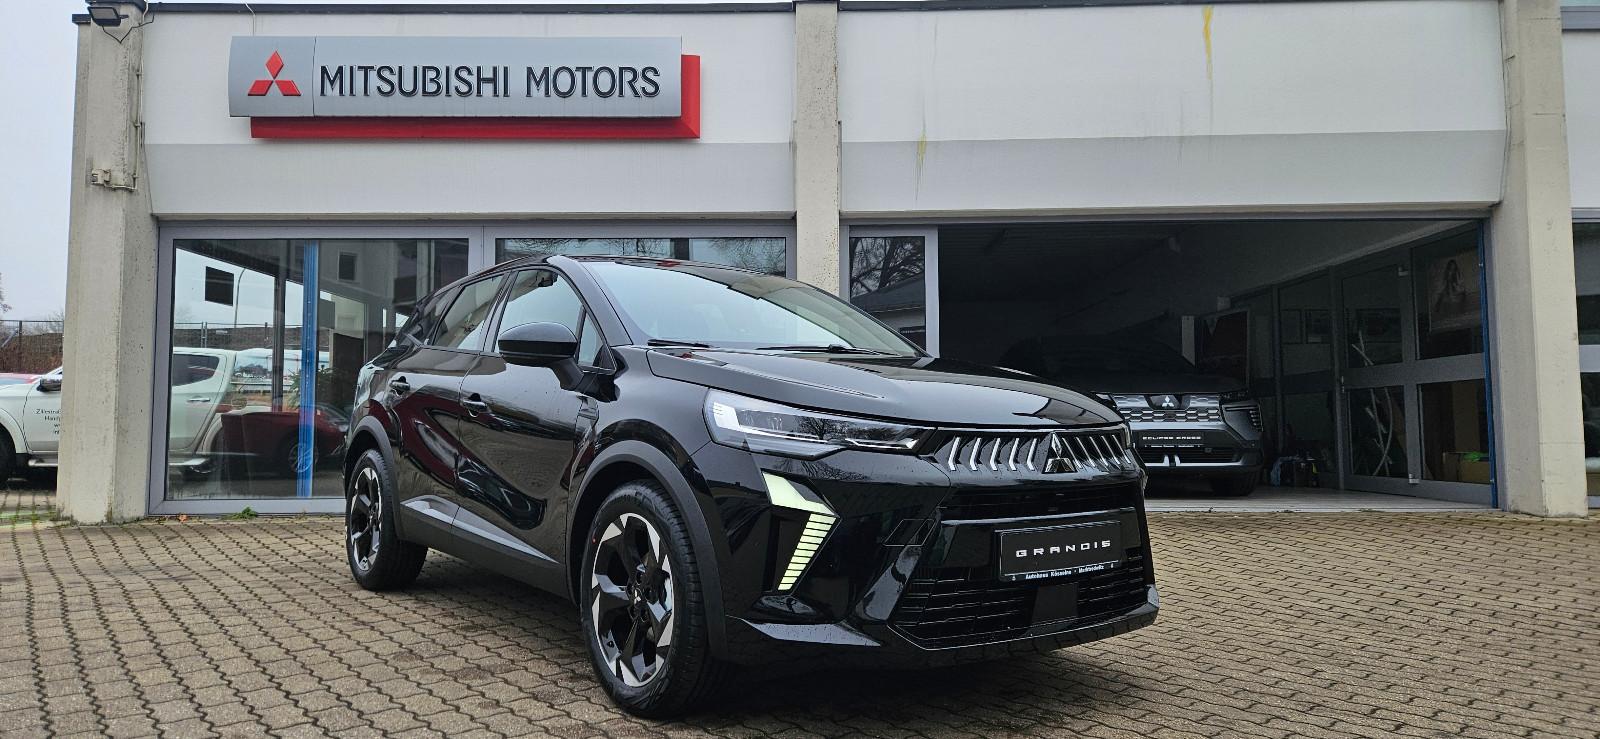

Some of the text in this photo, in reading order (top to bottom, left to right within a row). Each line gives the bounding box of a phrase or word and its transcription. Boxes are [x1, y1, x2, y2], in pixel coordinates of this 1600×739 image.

[319, 65, 661, 98] MITSUBISHI MOTORS
[1015, 540, 1111, 558] GRANDIS
